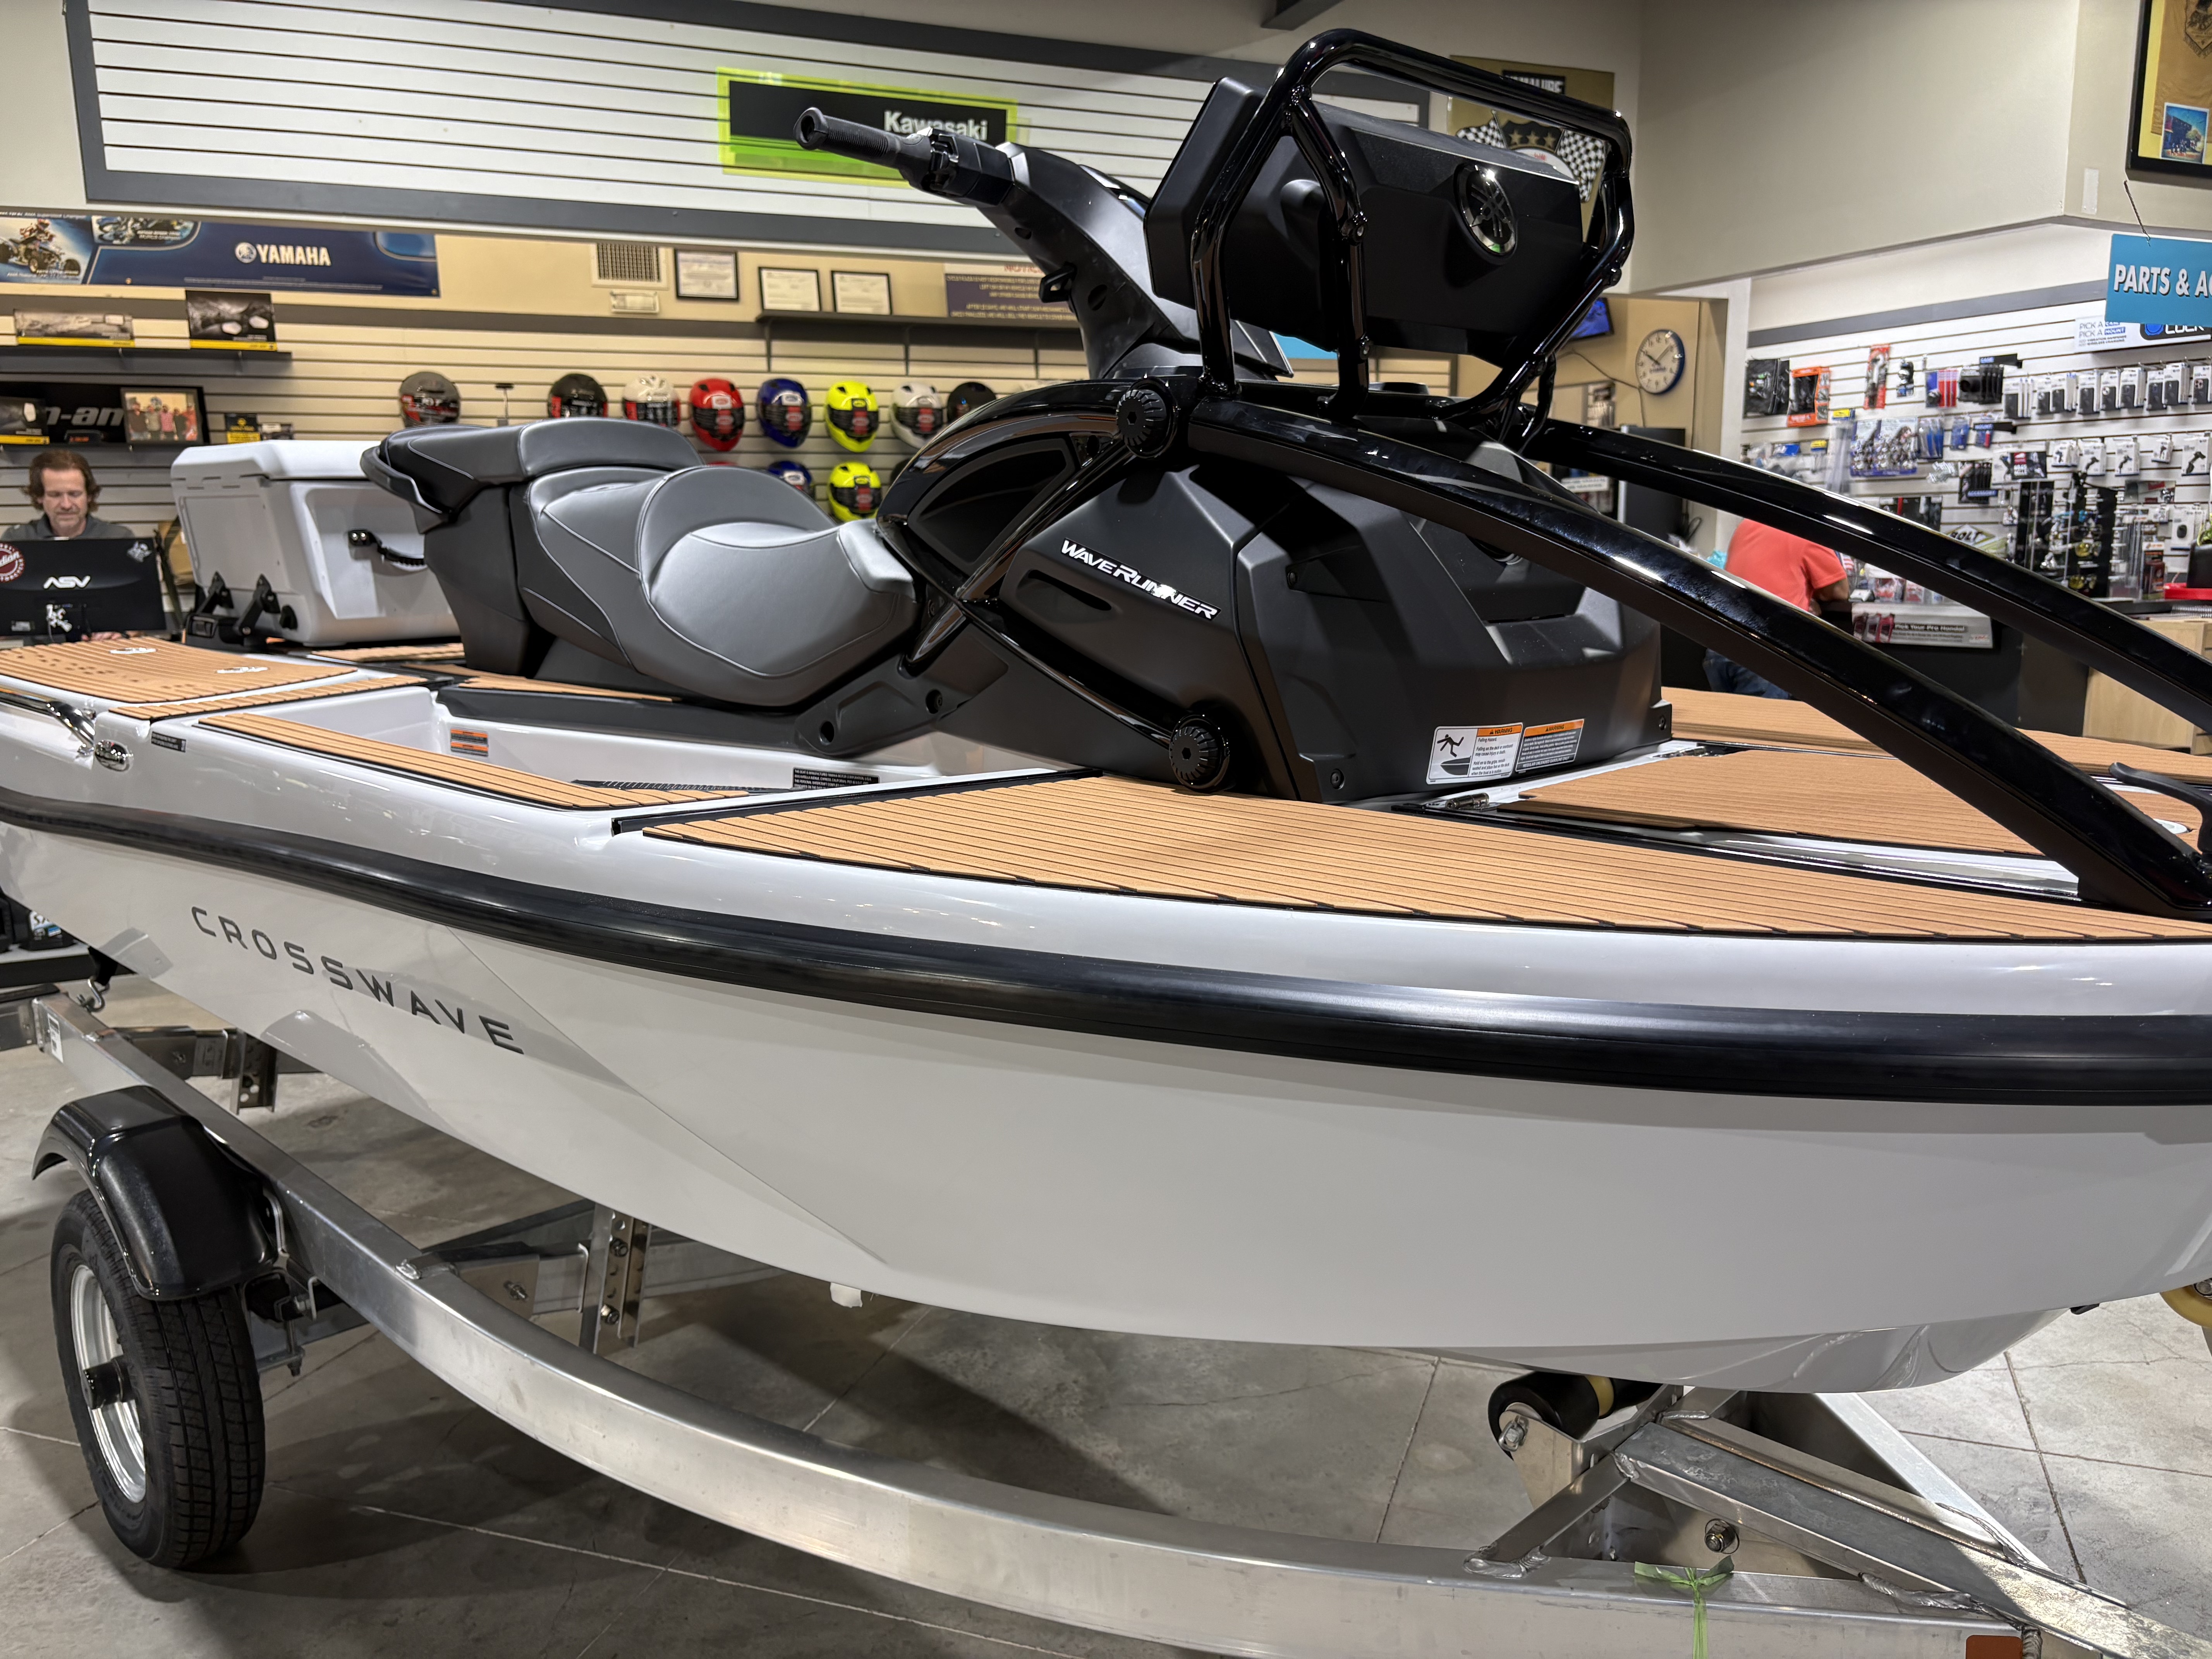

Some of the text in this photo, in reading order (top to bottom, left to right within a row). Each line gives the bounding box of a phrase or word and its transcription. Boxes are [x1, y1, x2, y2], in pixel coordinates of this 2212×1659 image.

[884, 110, 988, 141] Kawasaki
[256, 244, 331, 266] YAMAHA
[2114, 264, 2171, 295] PARTS
[2176, 268, 2190, 297] &
[2078, 330, 2095, 338] PICK
[1061, 540, 1218, 620] WAVERUNNER
[191, 906, 524, 1054] CROSSWAVE
